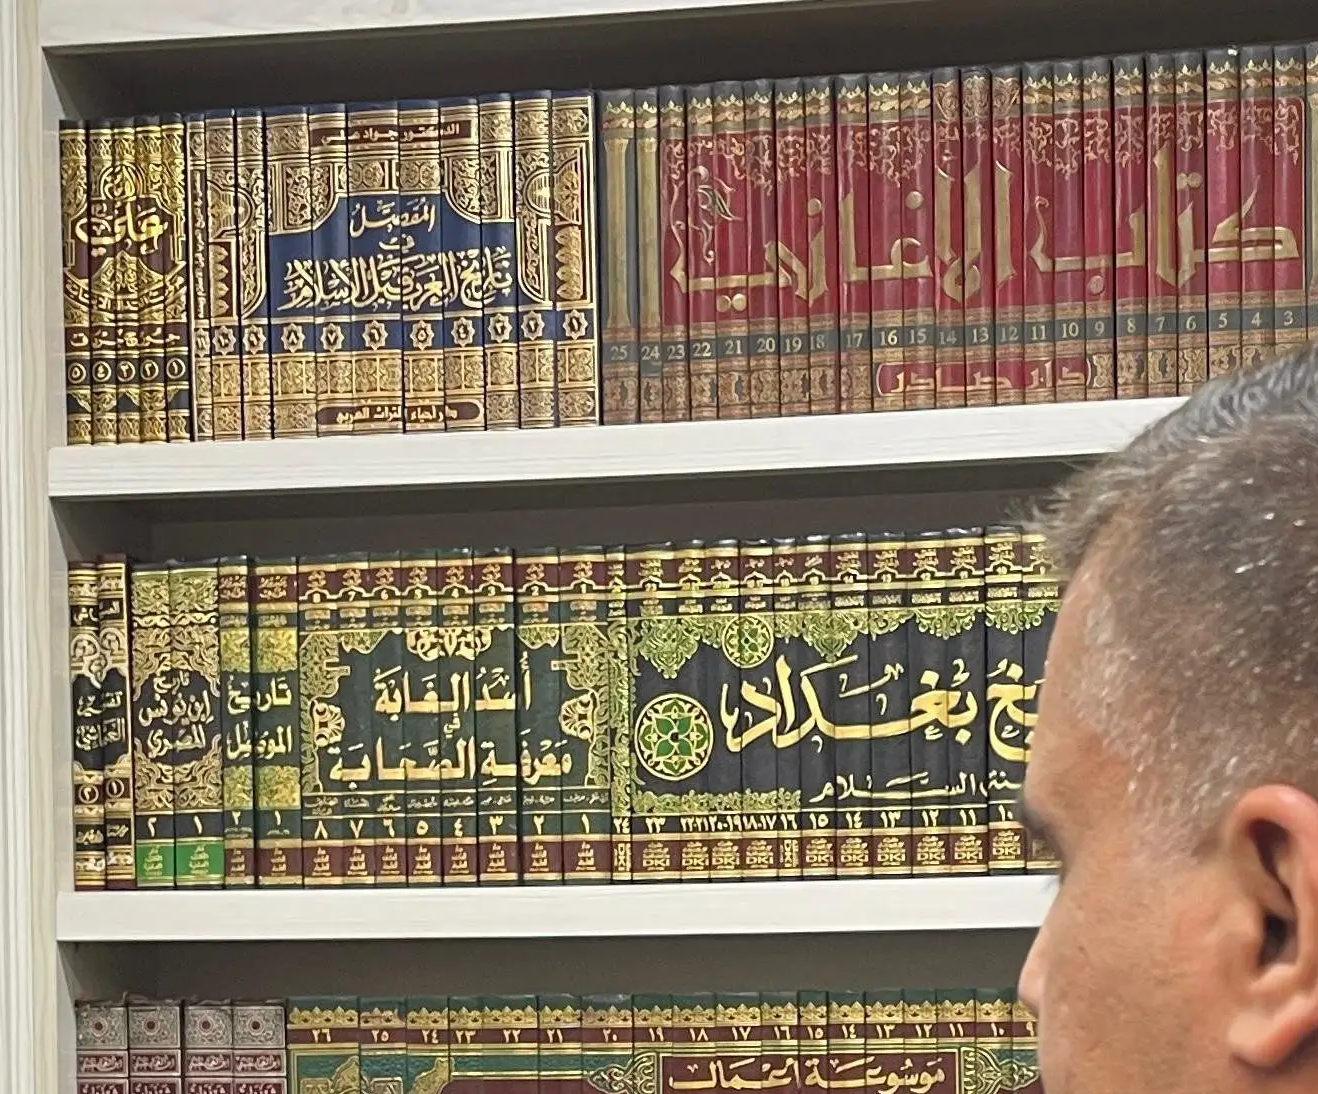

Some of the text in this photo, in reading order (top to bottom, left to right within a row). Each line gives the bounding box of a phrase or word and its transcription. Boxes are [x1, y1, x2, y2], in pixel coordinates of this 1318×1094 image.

[363, 127, 399, 141] جواد
[349, 197, 436, 238] المفصل
[1029, 145, 1300, 296] كتاب
[378, 233, 415, 253] في
[353, 254, 415, 309] قبل
[401, 250, 460, 311] العرب
[459, 246, 513, 308] تاريخ
[1125, 317, 1137, 334] 8
[1155, 315, 1166, 333] 7
[1185, 314, 1197, 331] 6
[1218, 311, 1228, 328] 5
[1250, 309, 1262, 327] 4
[1283, 308, 1294, 327] 3
[908, 328, 928, 344] 15
[969, 326, 989, 345] 13
[999, 325, 1019, 343] 12
[1030, 324, 1047, 342] 11
[1061, 322, 1080, 340] 10
[1094, 319, 1105, 336] 9
[809, 334, 826, 350] 18
[845, 332, 863, 348] 17
[879, 329, 898, 345] 16
[938, 330, 957, 346] 14
[610, 345, 628, 361] 25
[641, 344, 660, 361] 24
[666, 343, 685, 360] 23
[691, 342, 712, 358] 22
[725, 340, 743, 356] 21
[756, 338, 776, 354] 20
[784, 338, 802, 354] 19
[891, 360, 1086, 394] دار صادر
[227, 676, 292, 715] تاريخ
[374, 666, 471, 721] الغابة
[138, 692, 188, 727] يونس
[721, 654, 979, 752] بغداد
[443, 712, 461, 738] في
[148, 724, 206, 759] المصري
[227, 721, 292, 761] الموصل
[329, 734, 573, 789] معرفة الصحابة
[809, 771, 977, 803] السلام
[232, 811, 241, 825] ٢
[274, 810, 282, 826] ١
[780, 813, 798, 830] ١٦
[809, 813, 829, 830] ١٥
[845, 811, 863, 829] ١٤
[880, 811, 901, 828] ١٣
[921, 809, 939, 827] ١٢
[959, 808, 977, 826] ١١
[998, 804, 1014, 822] ١٠
[147, 816, 157, 838] ٢
[194, 815, 203, 835] ١
[314, 820, 328, 840] ٨
[349, 819, 364, 839] ٧
[383, 818, 395, 838] ٦
[416, 819, 428, 836] ٥
[454, 818, 463, 838] ٤
[488, 815, 503, 836] ٣
[533, 814, 544, 835] ٢
[581, 814, 590, 834] ١
[613, 817, 630, 834] ٢٤
[645, 817, 666, 834] ٢٣
[312, 1030, 332, 1043] ٢٦
[371, 1029, 389, 1043] ٢٥
[421, 1029, 439, 1044] ٢٤
[455, 1029, 476, 1044] ٢٣
[502, 1029, 522, 1043] ٢٢
[546, 1029, 563, 1043] ٢١
[602, 1028, 618, 1042] ٢٠
[648, 1028, 664, 1042] ١٩
[689, 1028, 709, 1041] ١٨
[732, 1027, 752, 1041] ١٧
[774, 1026, 792, 1041] ١٦
[808, 1026, 824, 1040] ١٥
[841, 1025, 857, 1039] ١٤
[876, 1025, 896, 1039] ١٣
[915, 1024, 933, 1038] ١٢
[948, 1023, 964, 1037] ١١
[990, 1023, 1005, 1037] ١٠
[1026, 1022, 1035, 1036] ٩
